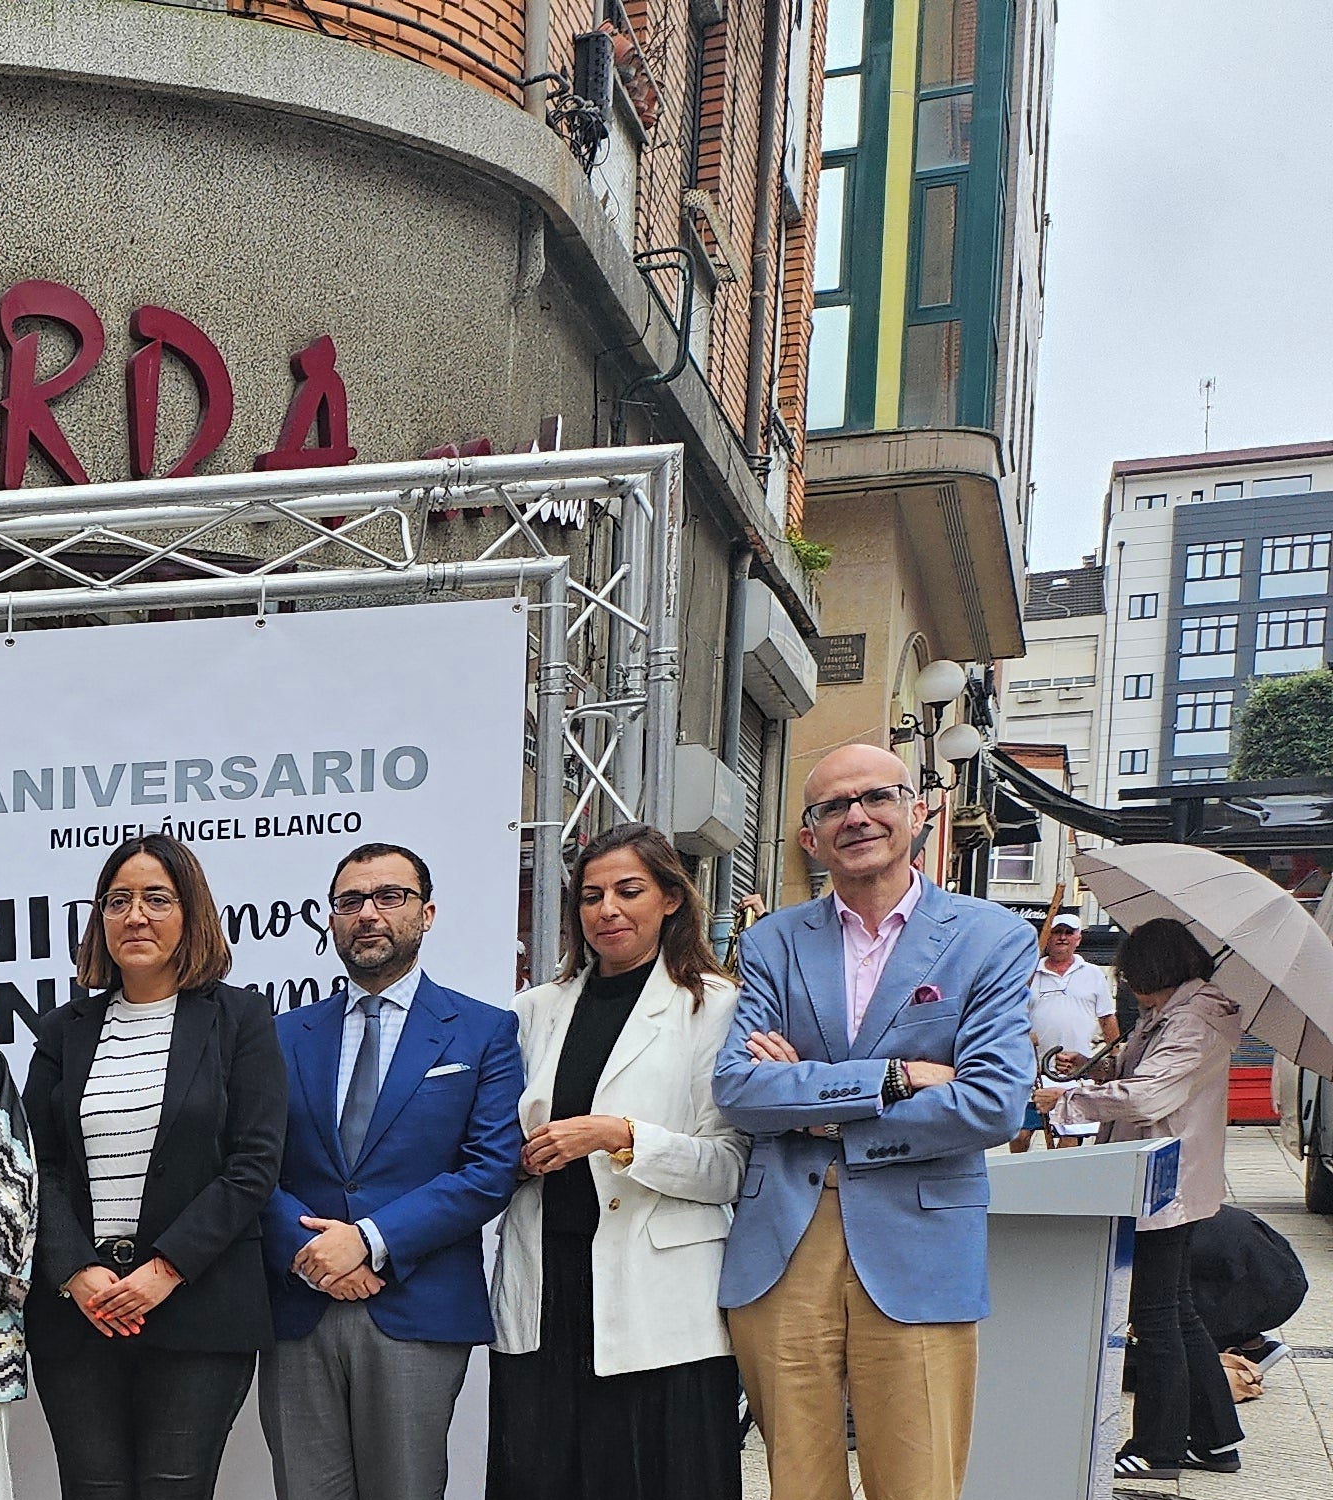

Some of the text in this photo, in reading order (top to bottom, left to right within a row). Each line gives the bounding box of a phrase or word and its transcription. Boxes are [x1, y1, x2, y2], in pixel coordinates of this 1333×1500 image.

[49, 811, 362, 850] MIGUEL ÁNGEL BLANCO
